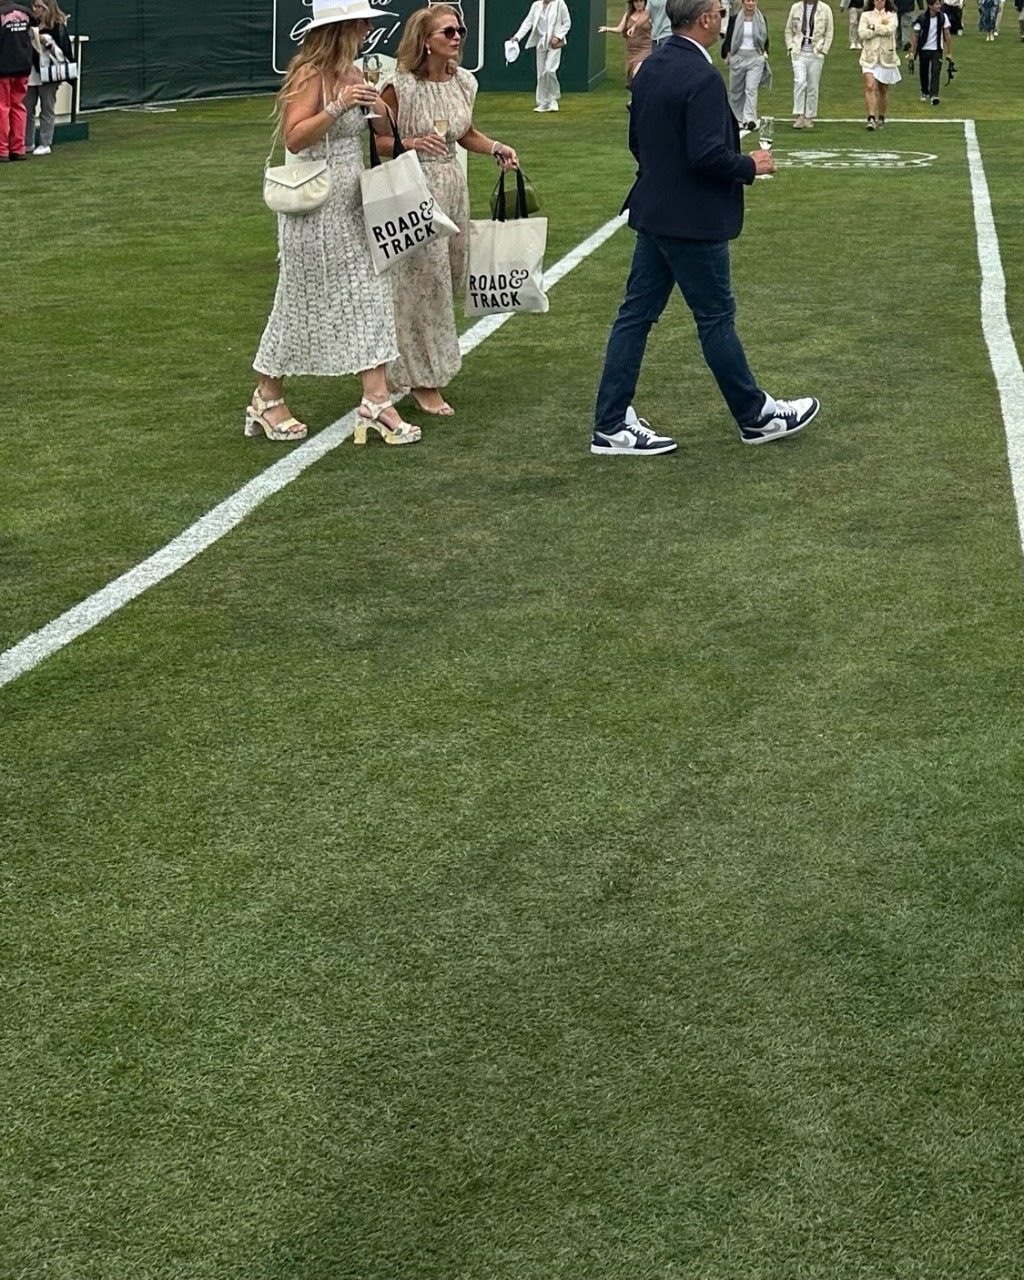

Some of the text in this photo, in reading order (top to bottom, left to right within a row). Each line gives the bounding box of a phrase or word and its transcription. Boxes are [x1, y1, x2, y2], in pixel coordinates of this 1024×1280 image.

[372, 198, 434, 242] ROAD&
[379, 222, 436, 259] TRACK
[469, 269, 529, 291] ROAD&
[471, 291, 521, 308] TRACK
